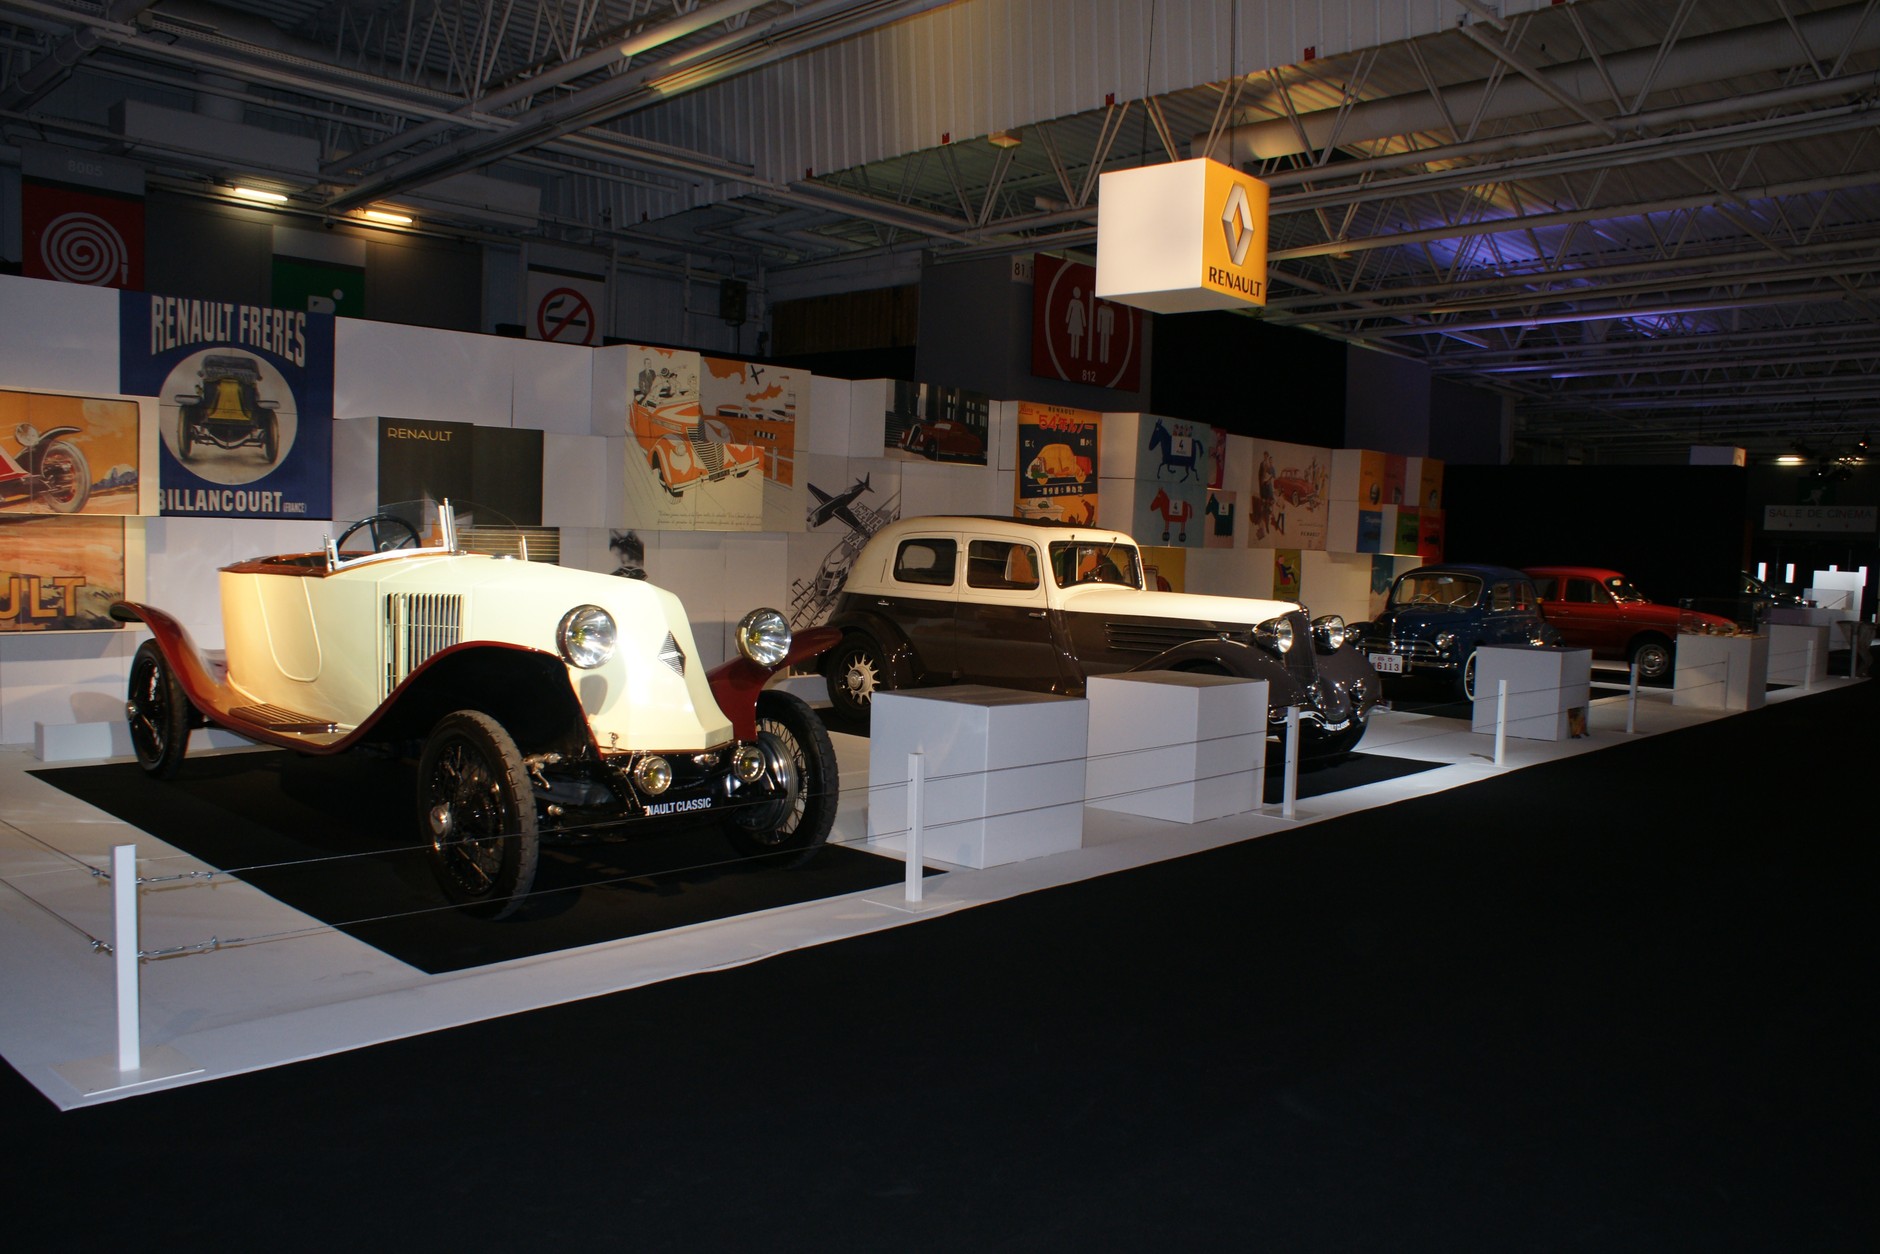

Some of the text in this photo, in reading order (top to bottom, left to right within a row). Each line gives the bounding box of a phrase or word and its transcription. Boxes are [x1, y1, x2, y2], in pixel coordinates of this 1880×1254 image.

[1209, 266, 1262, 297] RENAULT
[151, 295, 306, 368] RENAULT FRERES
[1081, 369, 1096, 382] 812
[387, 427, 452, 442] RENAULT
[283, 502, 308, 514] (FRANCE)
[1769, 509, 1872, 519] SALLE DE CINEMA
[1377, 662, 1399, 671] 6113
[676, 797, 711, 812] CLASSIC
